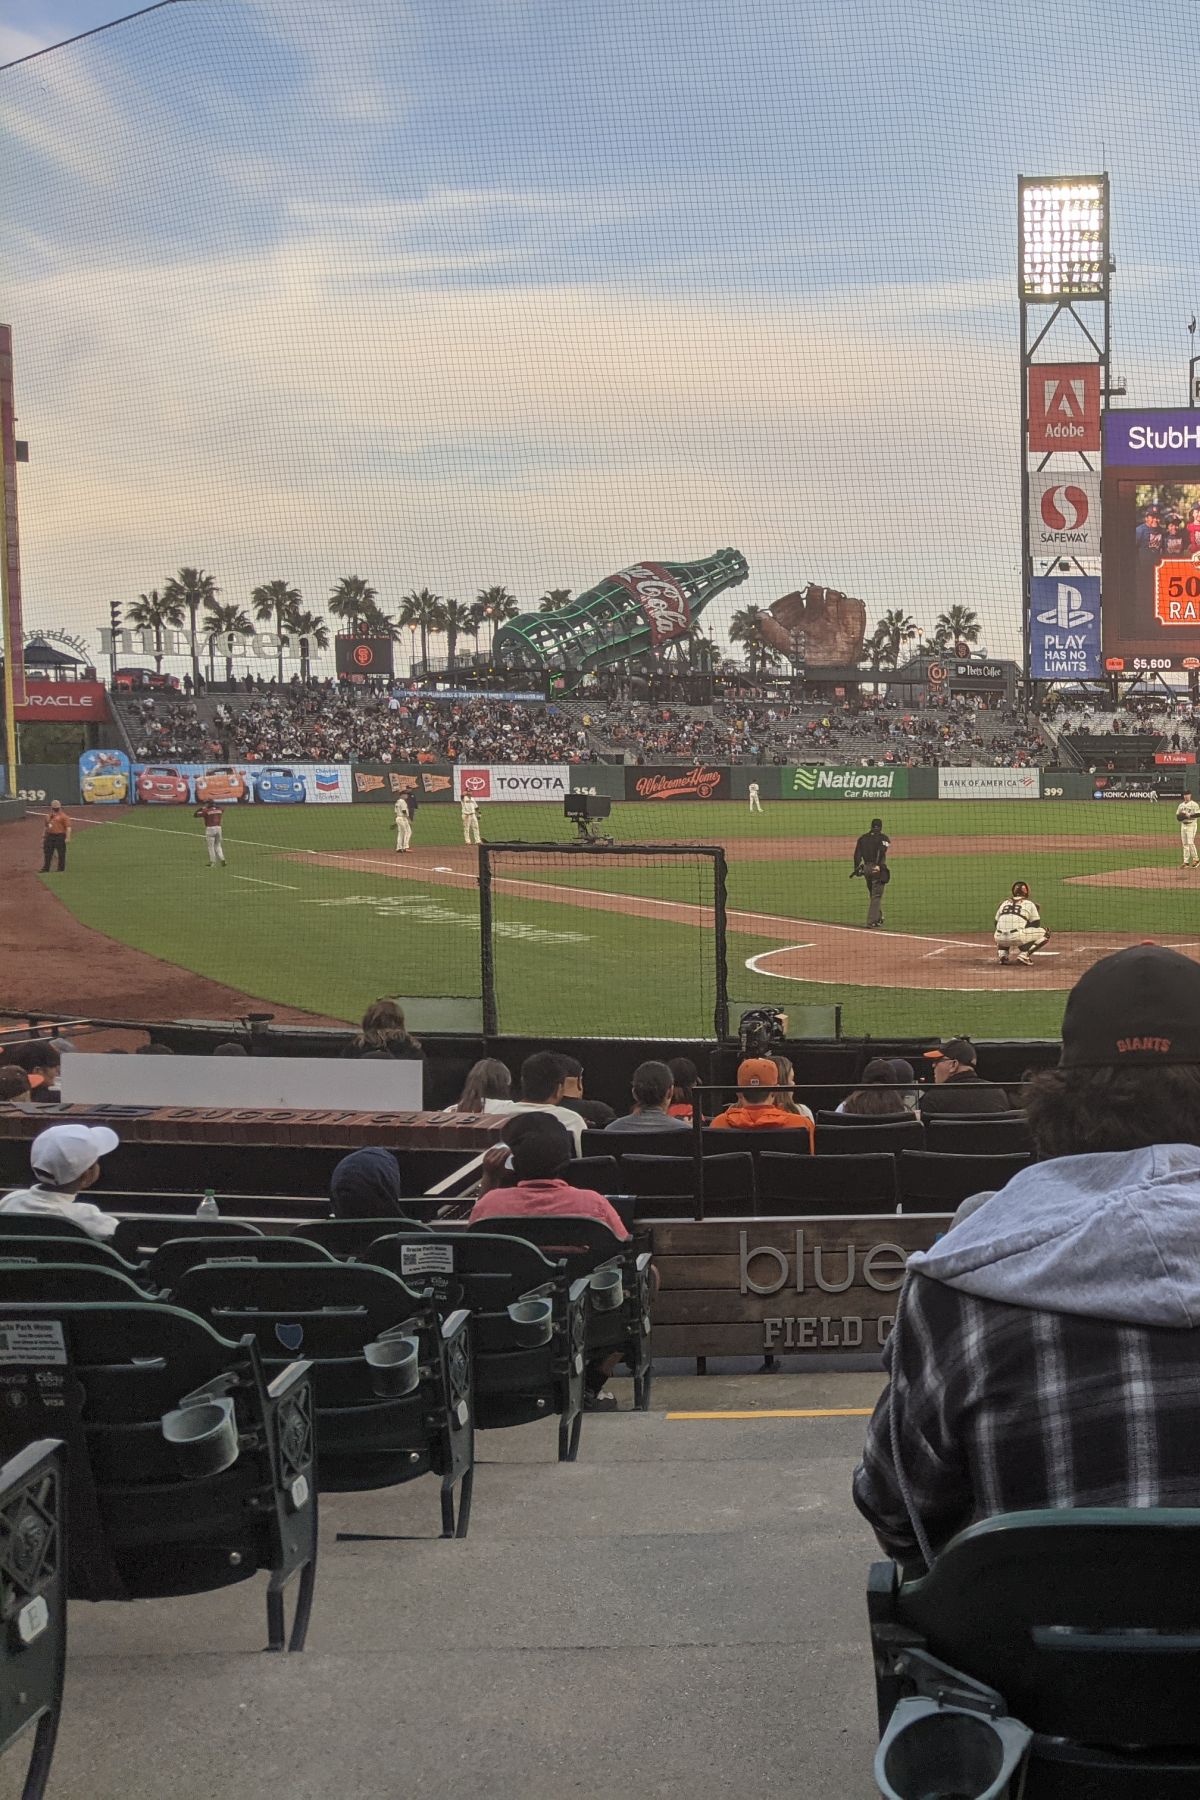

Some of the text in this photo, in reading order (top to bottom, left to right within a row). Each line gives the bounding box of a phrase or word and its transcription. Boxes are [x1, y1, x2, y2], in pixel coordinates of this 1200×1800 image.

[1045, 423, 1084, 438] Adobe
[1041, 533, 1088, 543] SAFEWAY
[97, 628, 322, 659] nuveen
[1044, 635, 1087, 649] PLAY
[1044, 651, 1087, 660] HAS NO
[1133, 658, 1171, 669] $5,600
[983, 666, 1001, 677] Coffee
[497, 777, 564, 790] TOYOTA
[636, 768, 720, 796] Welcome Home
[816, 771, 895, 788] National
[18, 789, 46, 801] 339
[844, 790, 891, 798] Car Rental
[1044, 788, 1063, 796] 399
[1103, 791, 1129, 799] KONICA
[1116, 1037, 1171, 1053] GIANTS
[168, 1109, 357, 1122] DUGOUT
[371, 1114, 479, 1125] CLUB
[739, 1229, 908, 1296] blue
[763, 1316, 863, 1348] FIELD
